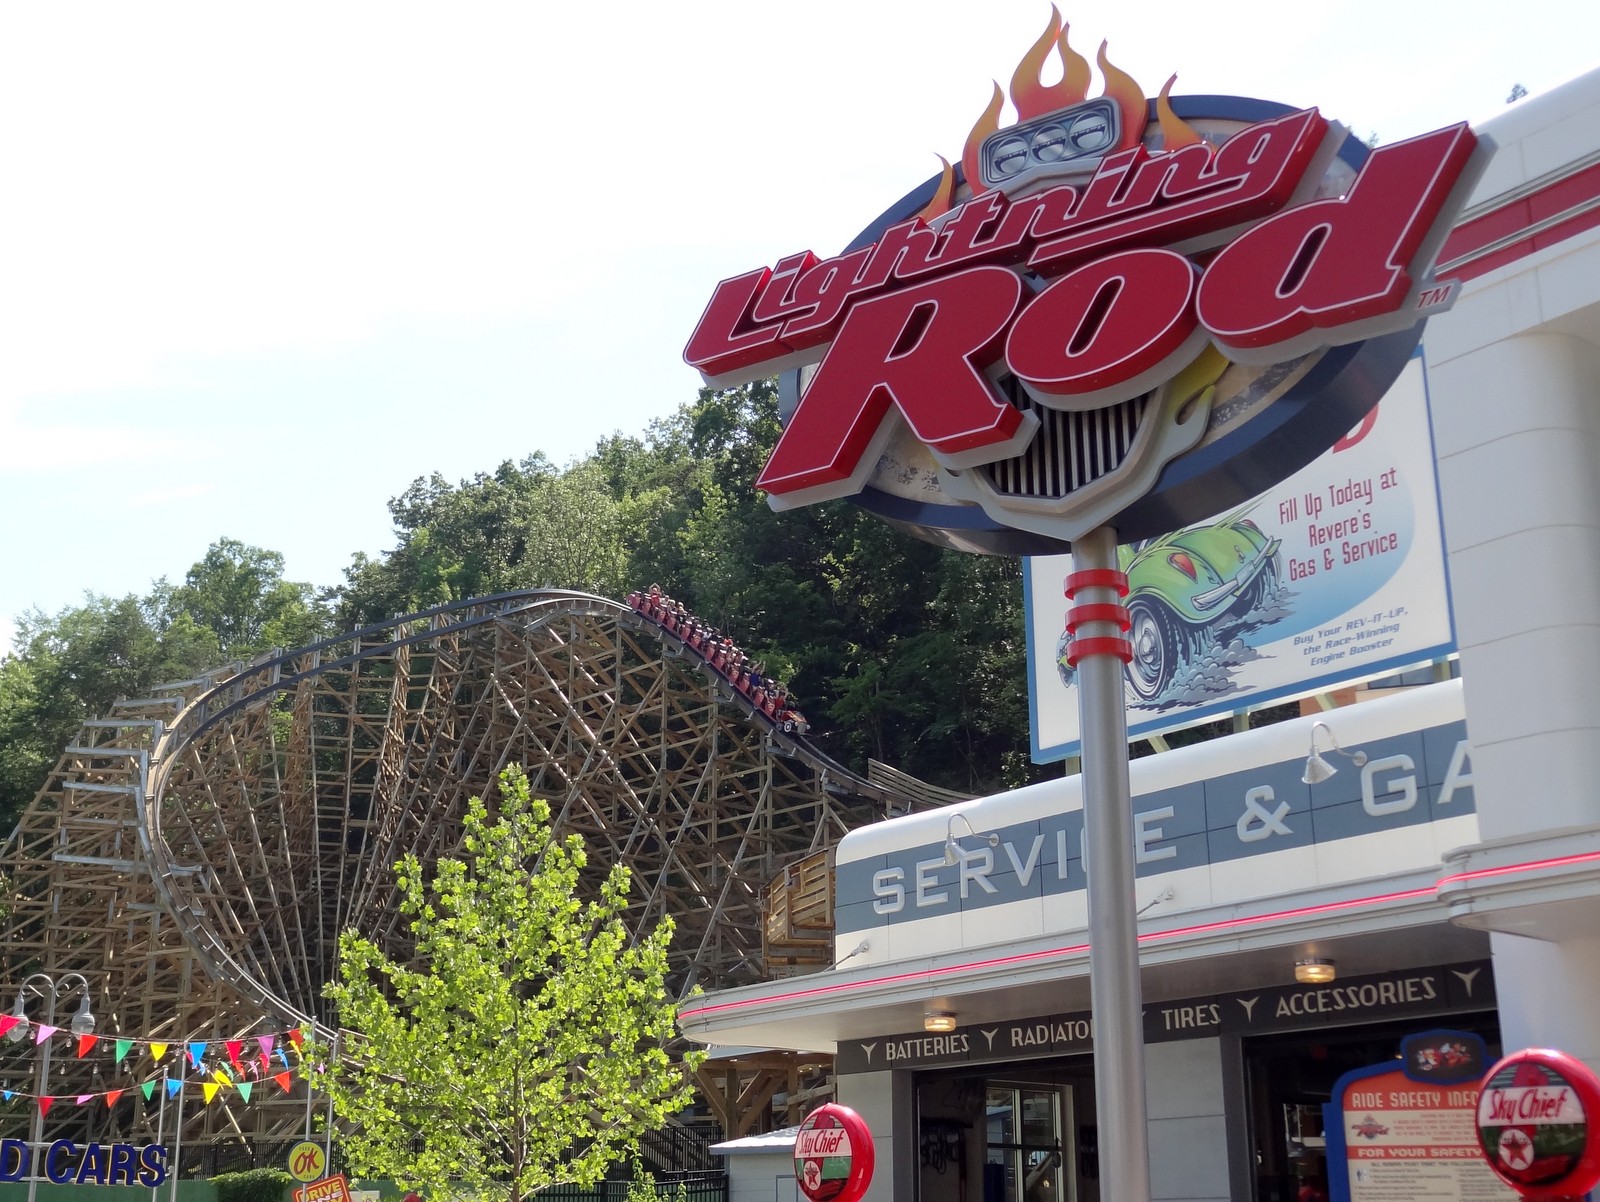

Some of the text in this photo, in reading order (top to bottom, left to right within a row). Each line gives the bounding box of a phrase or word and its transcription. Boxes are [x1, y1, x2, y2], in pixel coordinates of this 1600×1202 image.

[683, 106, 1322, 370] Lightning
[754, 120, 1472, 492] Rod TM
[1279, 467, 1398, 525] Fill Up Today at
[1308, 509, 1371, 547] Revere's
[1289, 531, 1398, 581] Gas & Service
[1293, 635, 1314, 646] Buy
[1318, 626, 1342, 639] Your
[1303, 623, 1400, 655] the Race-Winning
[1310, 638, 1394, 666] Engine Booster
[872, 805, 1177, 914] SERVIE
[1236, 784, 1294, 843] &
[885, 976, 1437, 1061] BATTERIES RADIATO TIRES ACCESSORIES
[1351, 1092, 1383, 1108] RIDE
[1389, 1091, 1440, 1108] SAFETY
[1489, 1088, 1569, 1124] Sky Chief
[799, 1129, 845, 1156] Sky Chief
[1357, 1147, 1482, 1158] FOR YOUR SAFETY
[45, 1138, 167, 1188] CARS
[294, 1147, 320, 1175] OK
[299, 1181, 342, 1202] DRIVE
[310, 1190, 344, 1202] NE
